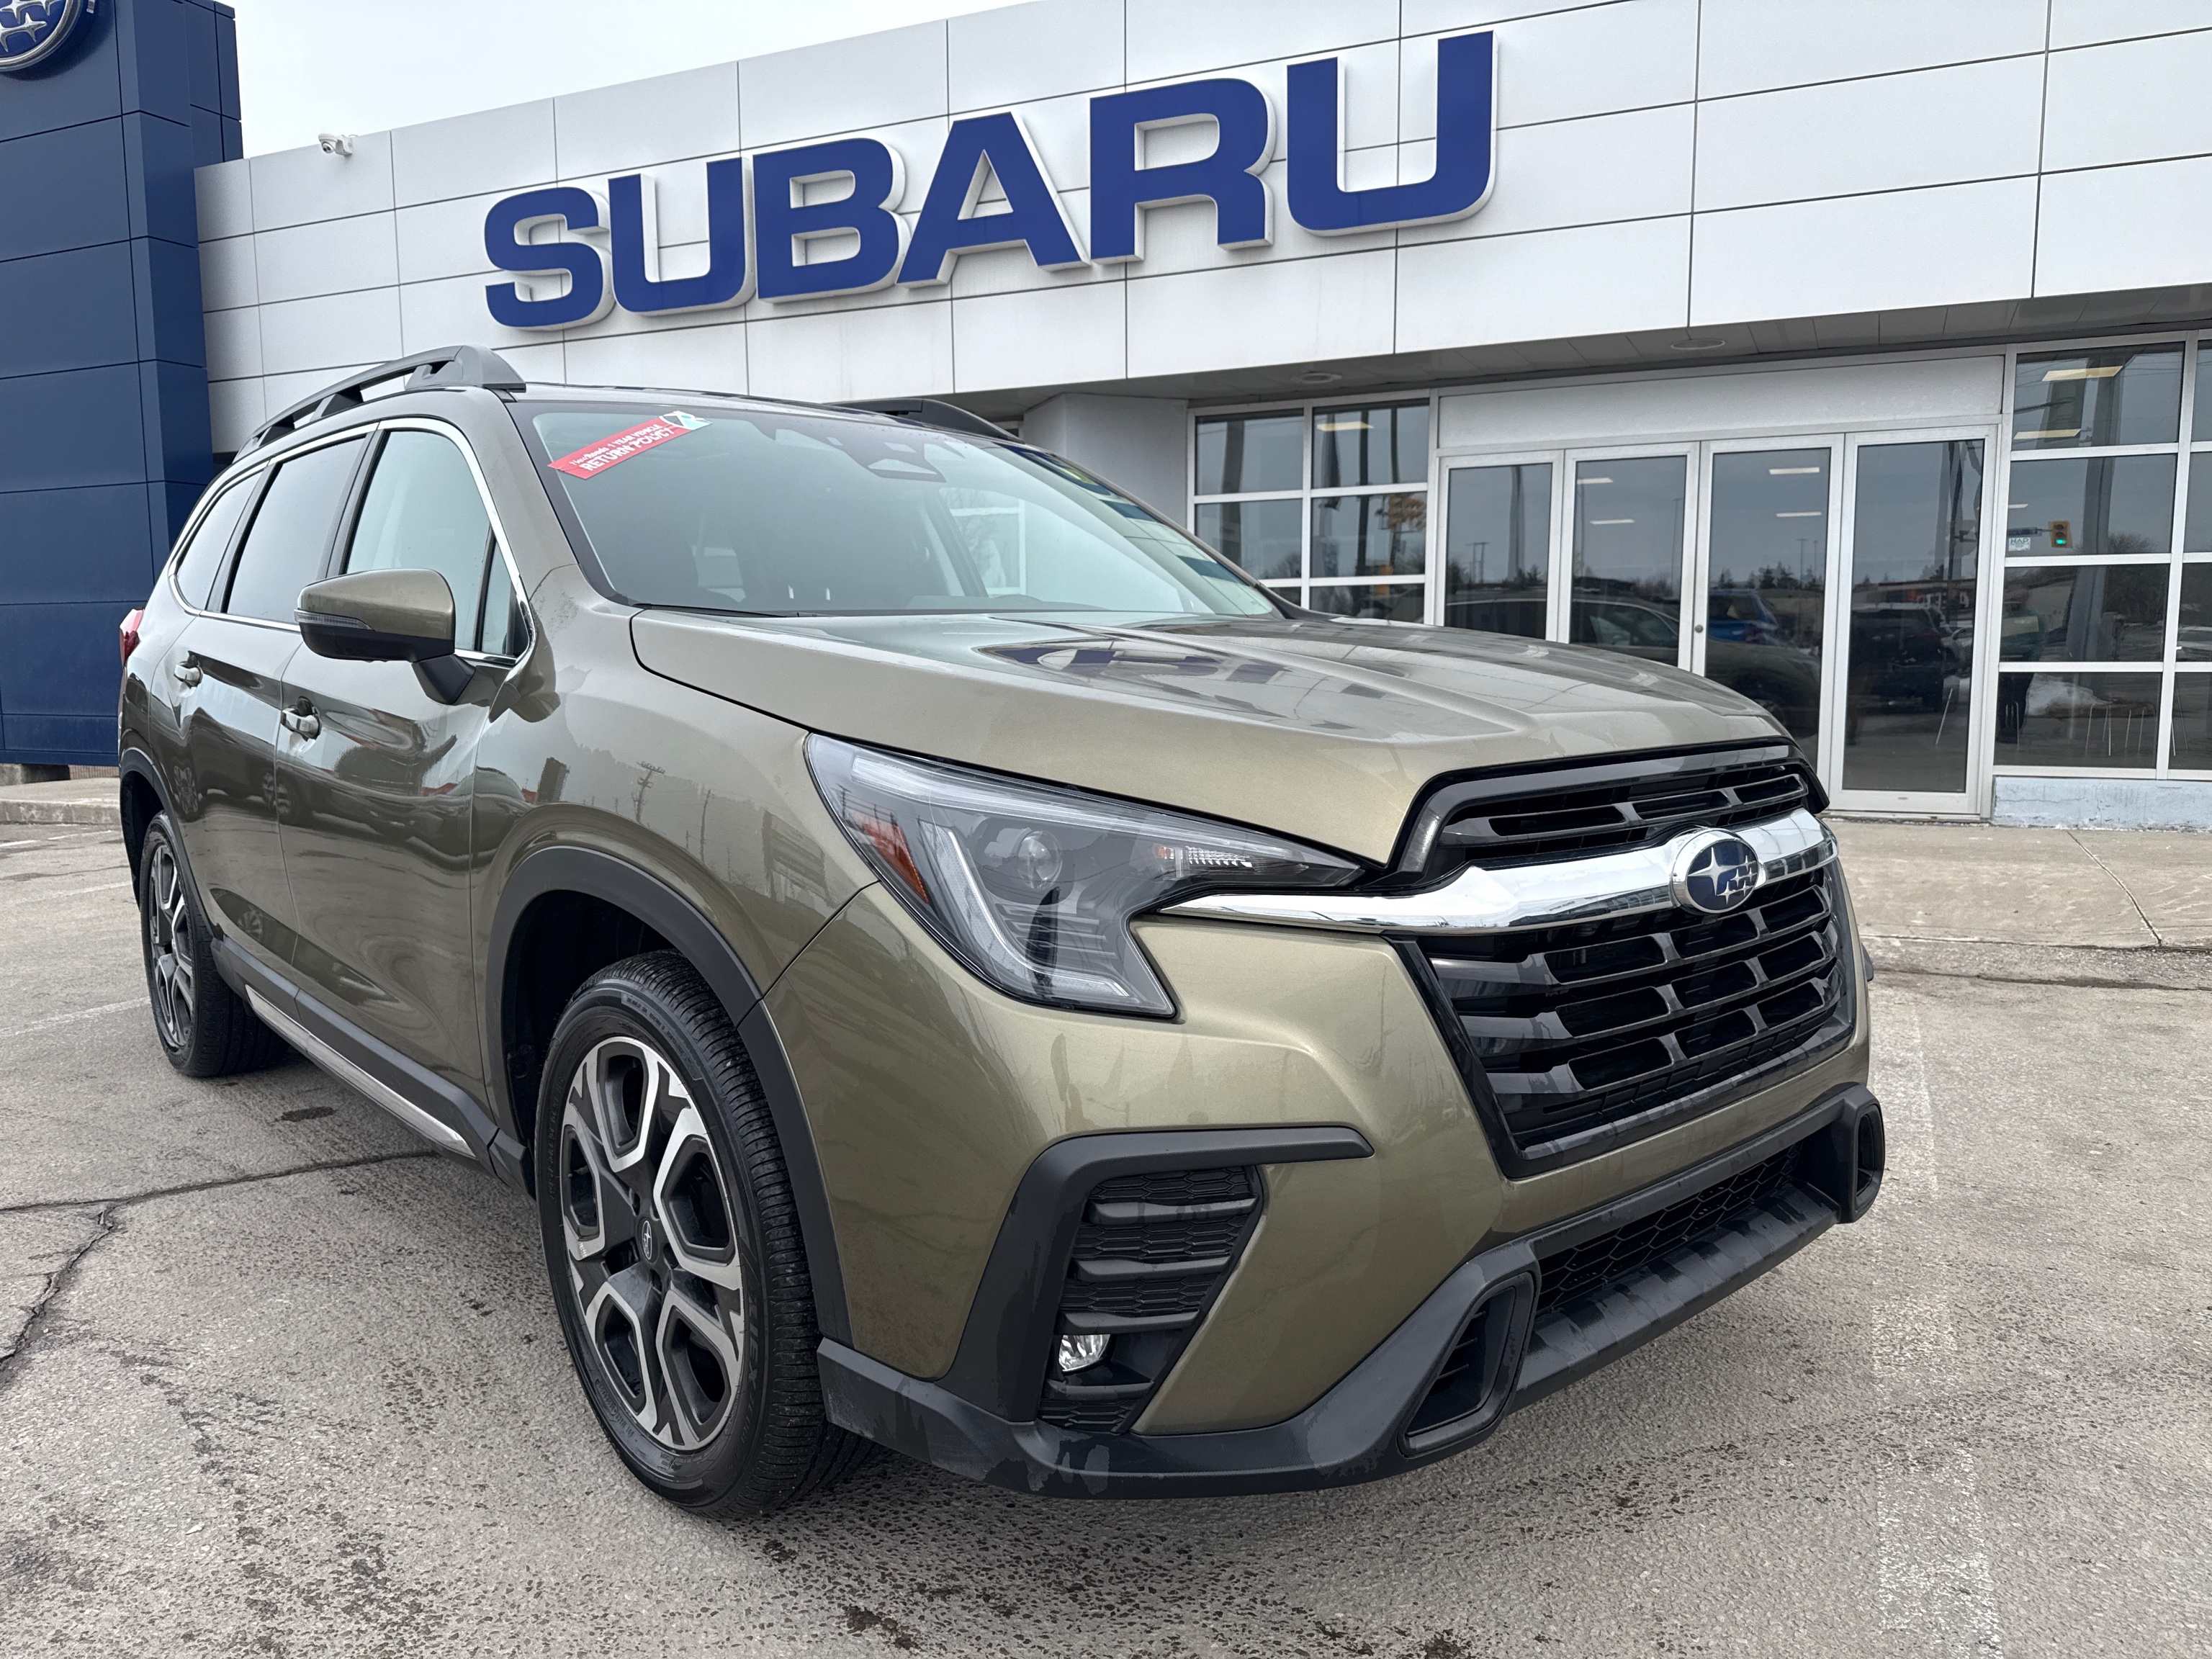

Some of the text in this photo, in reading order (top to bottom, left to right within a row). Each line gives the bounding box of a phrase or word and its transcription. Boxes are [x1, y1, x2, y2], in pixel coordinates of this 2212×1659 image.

[485, 31, 1495, 331] SUBARU
[579, 427, 674, 471] RETURN POLICY
[613, 434, 635, 446] YEAR
[631, 423, 663, 438] VEHICLE
